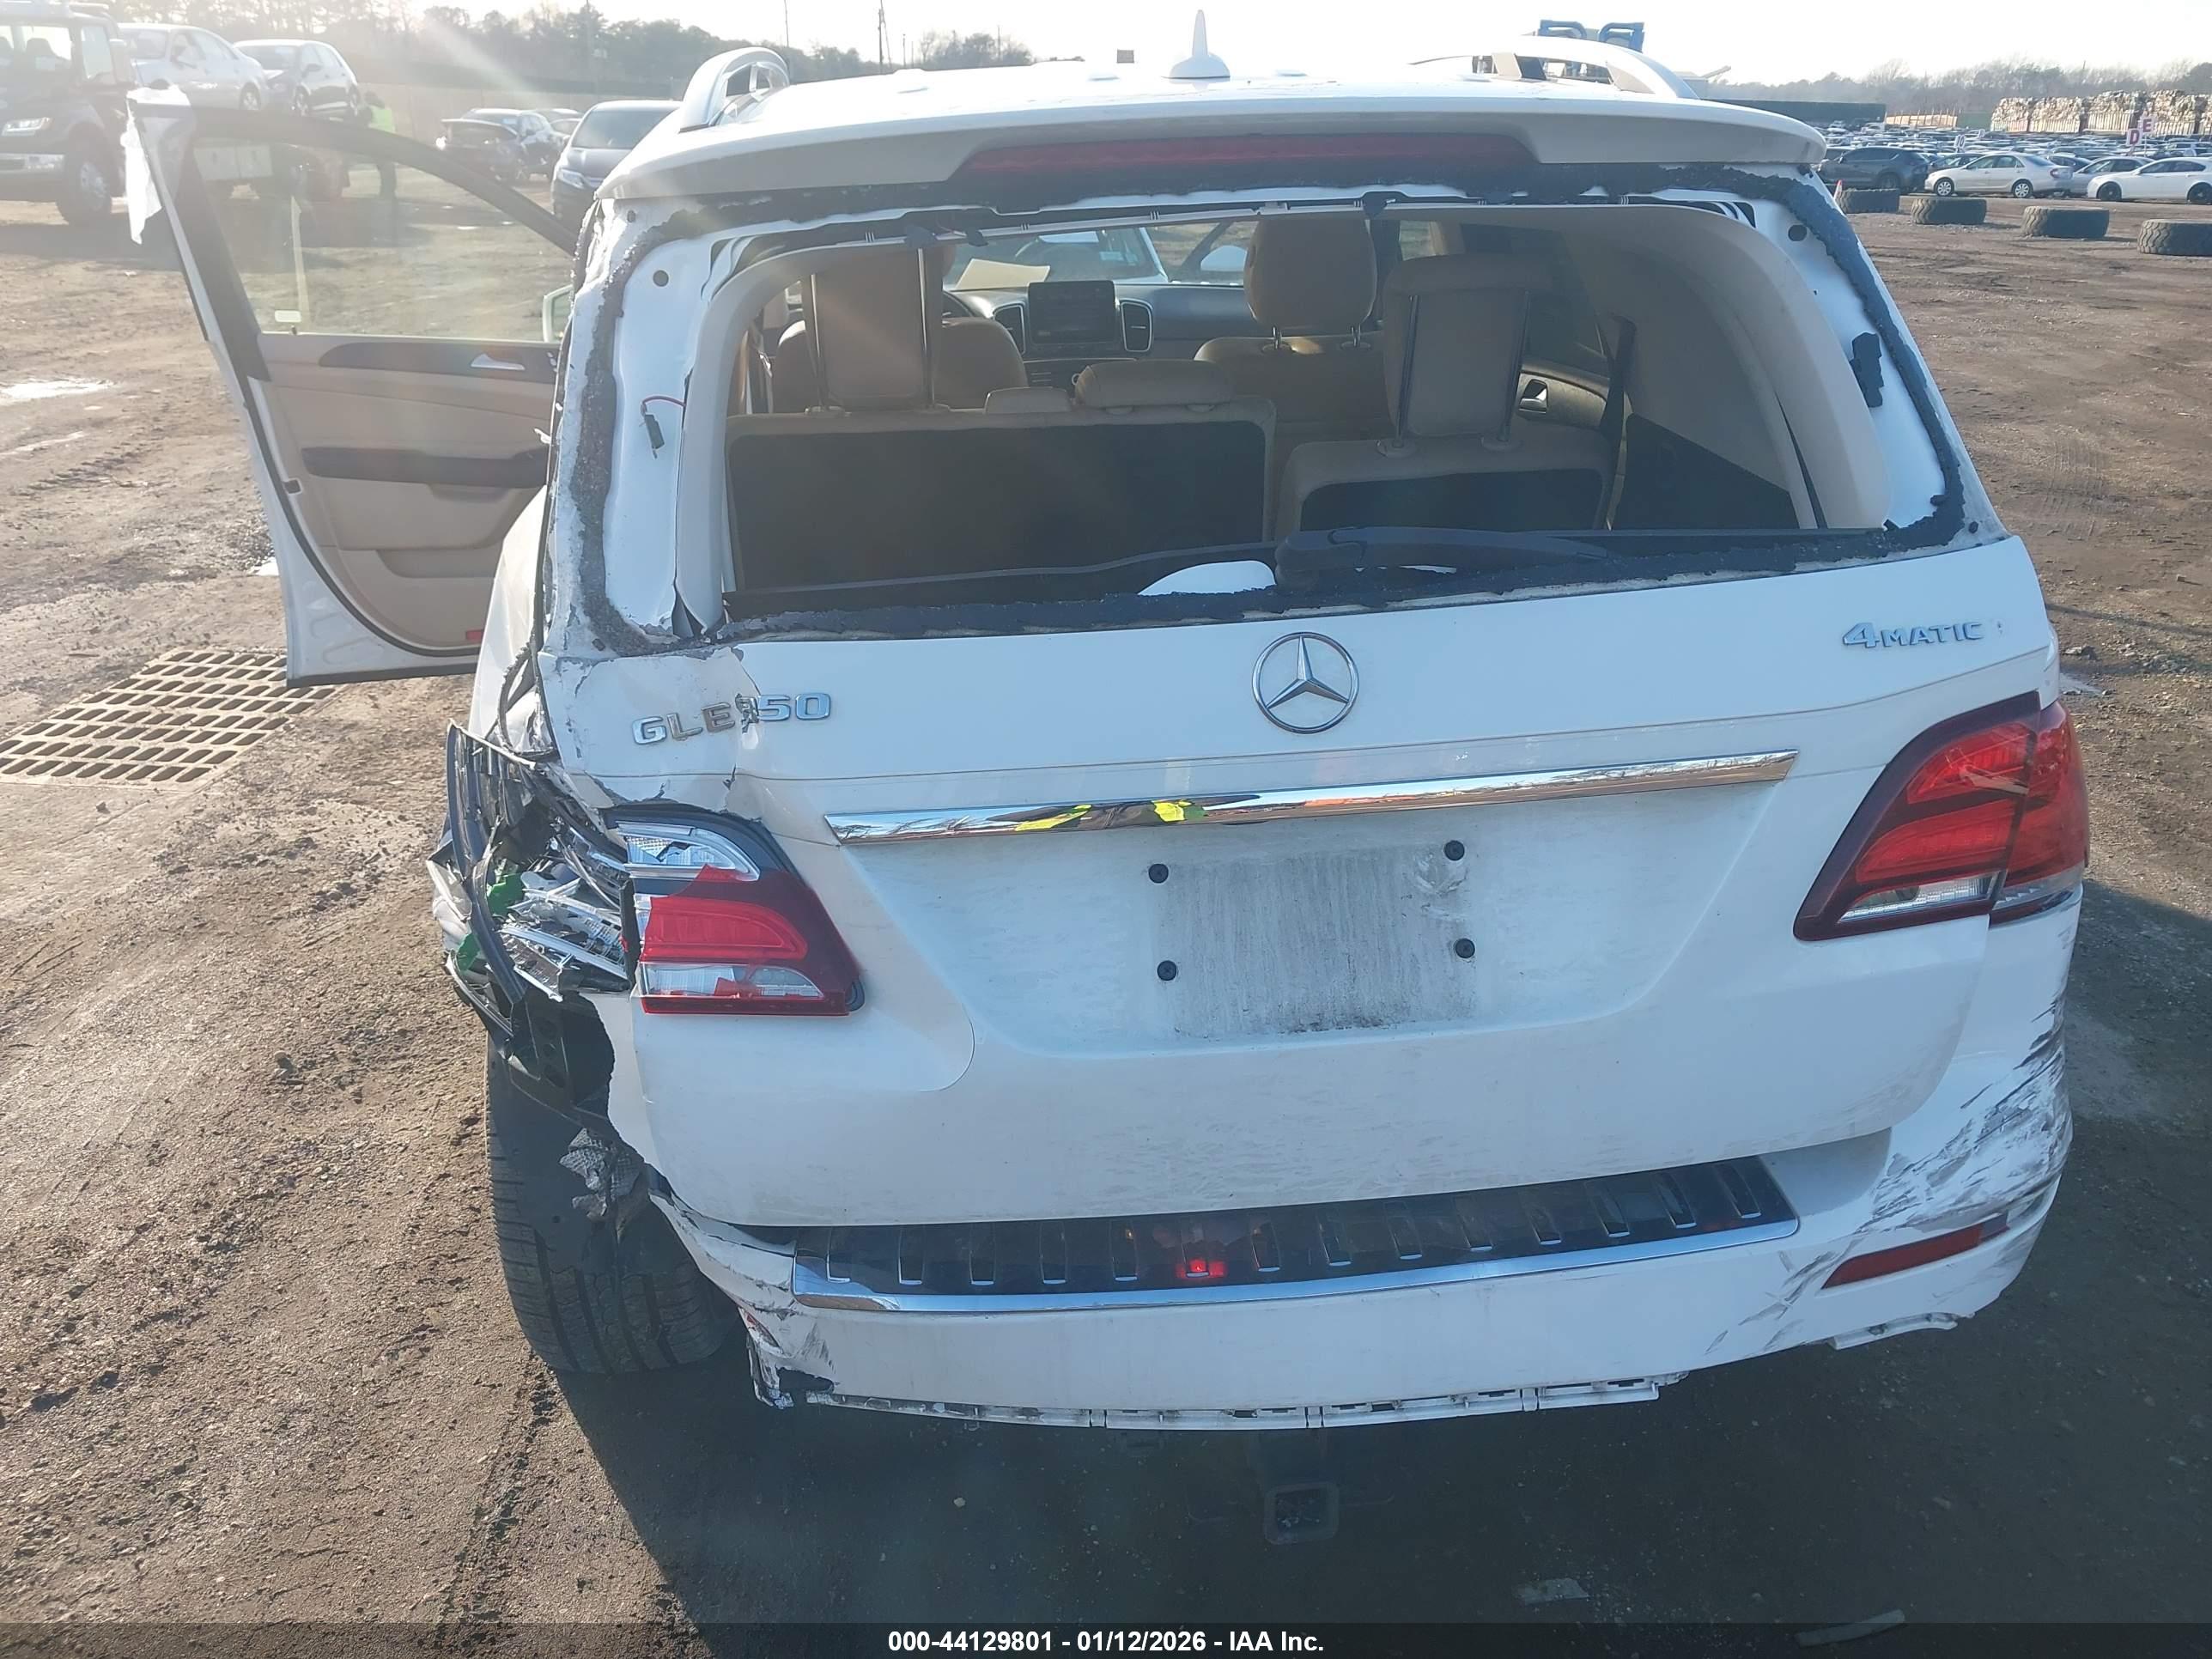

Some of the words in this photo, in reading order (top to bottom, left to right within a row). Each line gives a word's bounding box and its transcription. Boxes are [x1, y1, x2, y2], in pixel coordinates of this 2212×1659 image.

[2143, 118, 2152, 132] E
[2130, 129, 2140, 145] D
[1843, 622, 1984, 649] 4MATIC
